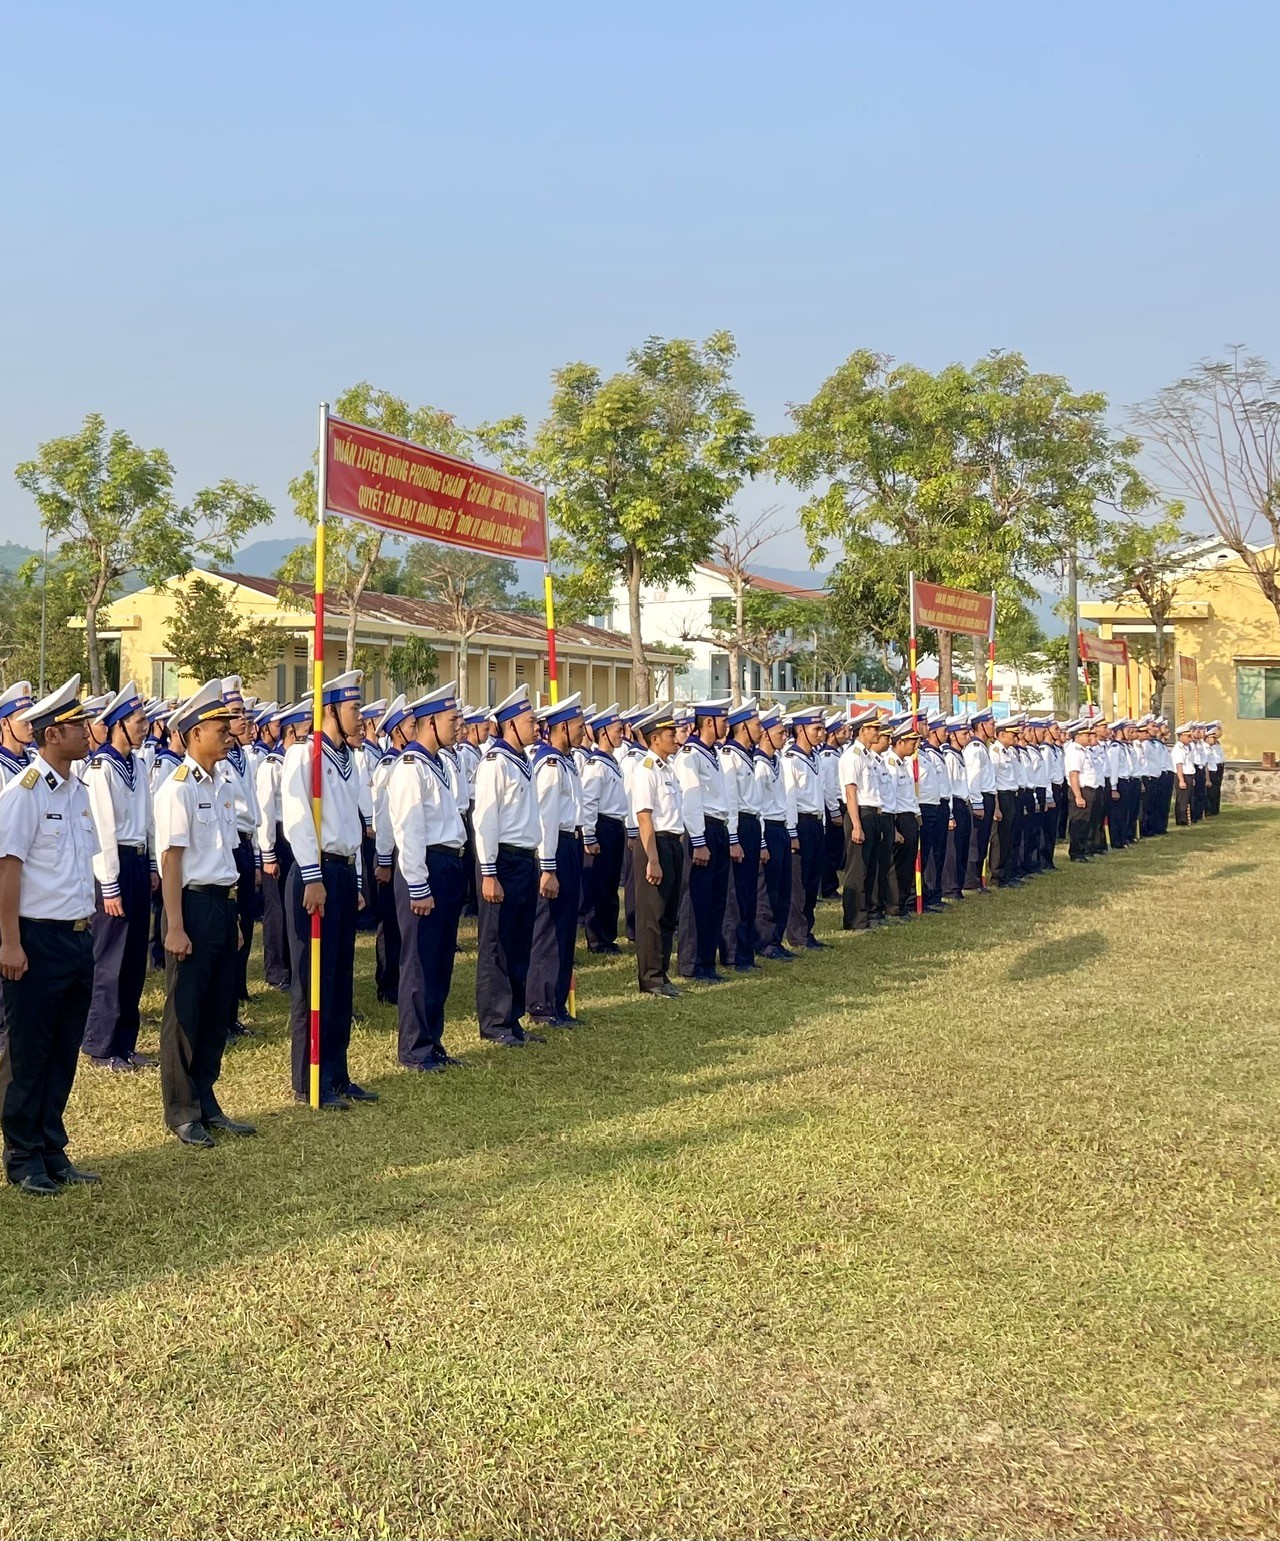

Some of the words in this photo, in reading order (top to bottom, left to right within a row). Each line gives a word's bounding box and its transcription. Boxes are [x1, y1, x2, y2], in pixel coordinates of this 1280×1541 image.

[334, 435, 357, 466] HUẤN
[357, 447, 386, 477] LUYỆN
[385, 453, 409, 482] ĐÚNG
[408, 462, 442, 492] PHƯƠNG
[441, 473, 467, 499] CHÂM
[359, 483, 384, 512] QUYẾT
[383, 489, 402, 517] TÂM
[401, 498, 418, 525] ĐẠT
[415, 502, 438, 527] DANH
[436, 506, 456, 534] HIỆU
